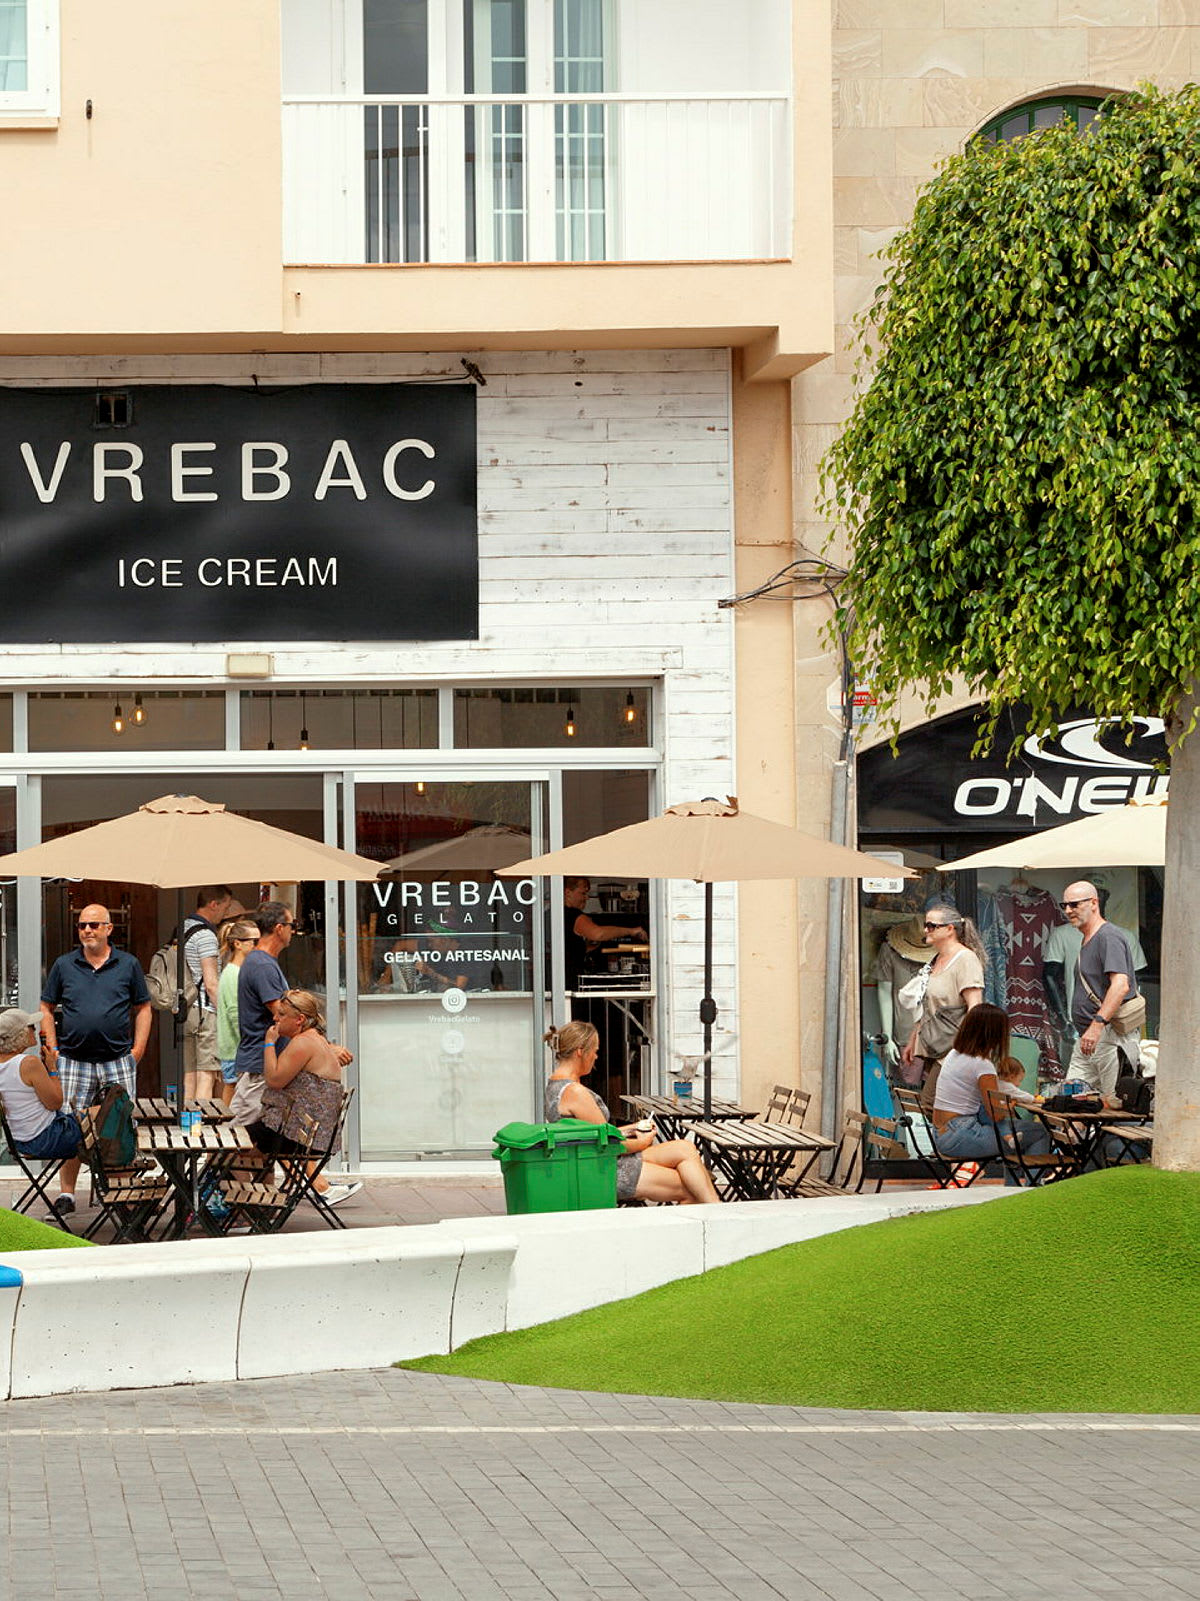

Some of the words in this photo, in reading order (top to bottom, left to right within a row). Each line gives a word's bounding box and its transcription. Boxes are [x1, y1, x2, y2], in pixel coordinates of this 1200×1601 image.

[20, 439, 437, 503] VREBAC
[118, 559, 183, 587] ICE
[198, 558, 337, 587] CREAM
[954, 775, 1170, 816] O'NEI
[372, 879, 538, 908] VREBAC
[387, 911, 524, 925] GELATO
[384, 951, 441, 963] GELATO
[445, 949, 530, 962] ARTESANAL
